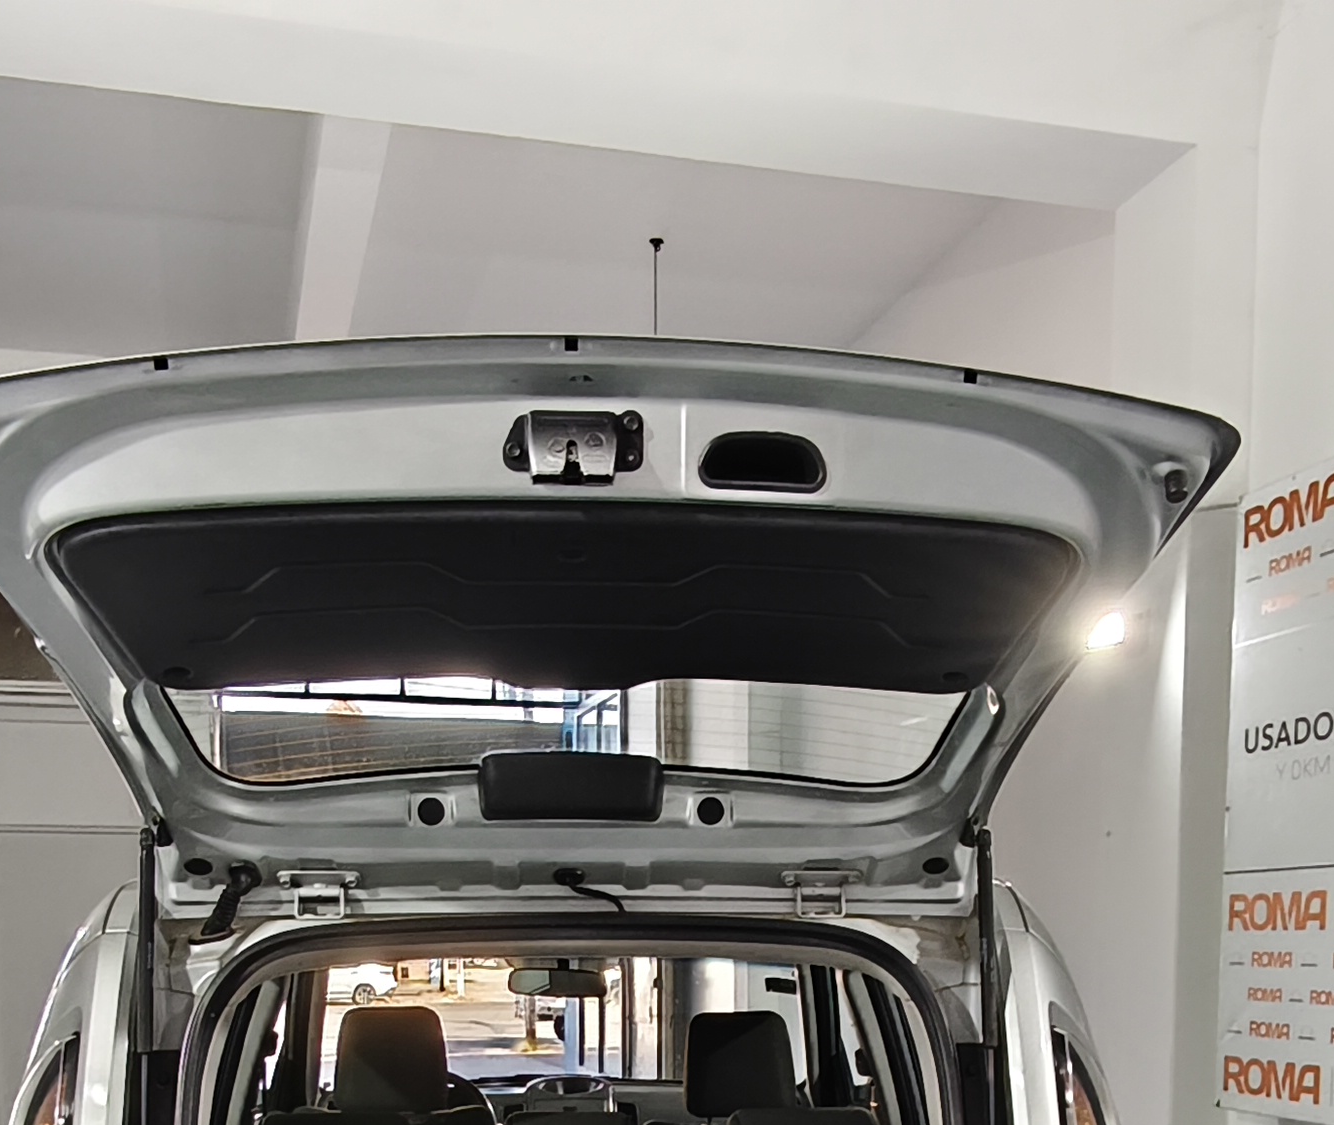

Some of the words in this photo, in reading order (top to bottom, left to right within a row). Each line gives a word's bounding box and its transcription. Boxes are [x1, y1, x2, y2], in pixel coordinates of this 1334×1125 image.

[1227, 889, 1327, 931] ROMA
[1252, 951, 1290, 968] ROMA
[1223, 1055, 1321, 1107] ROMA
